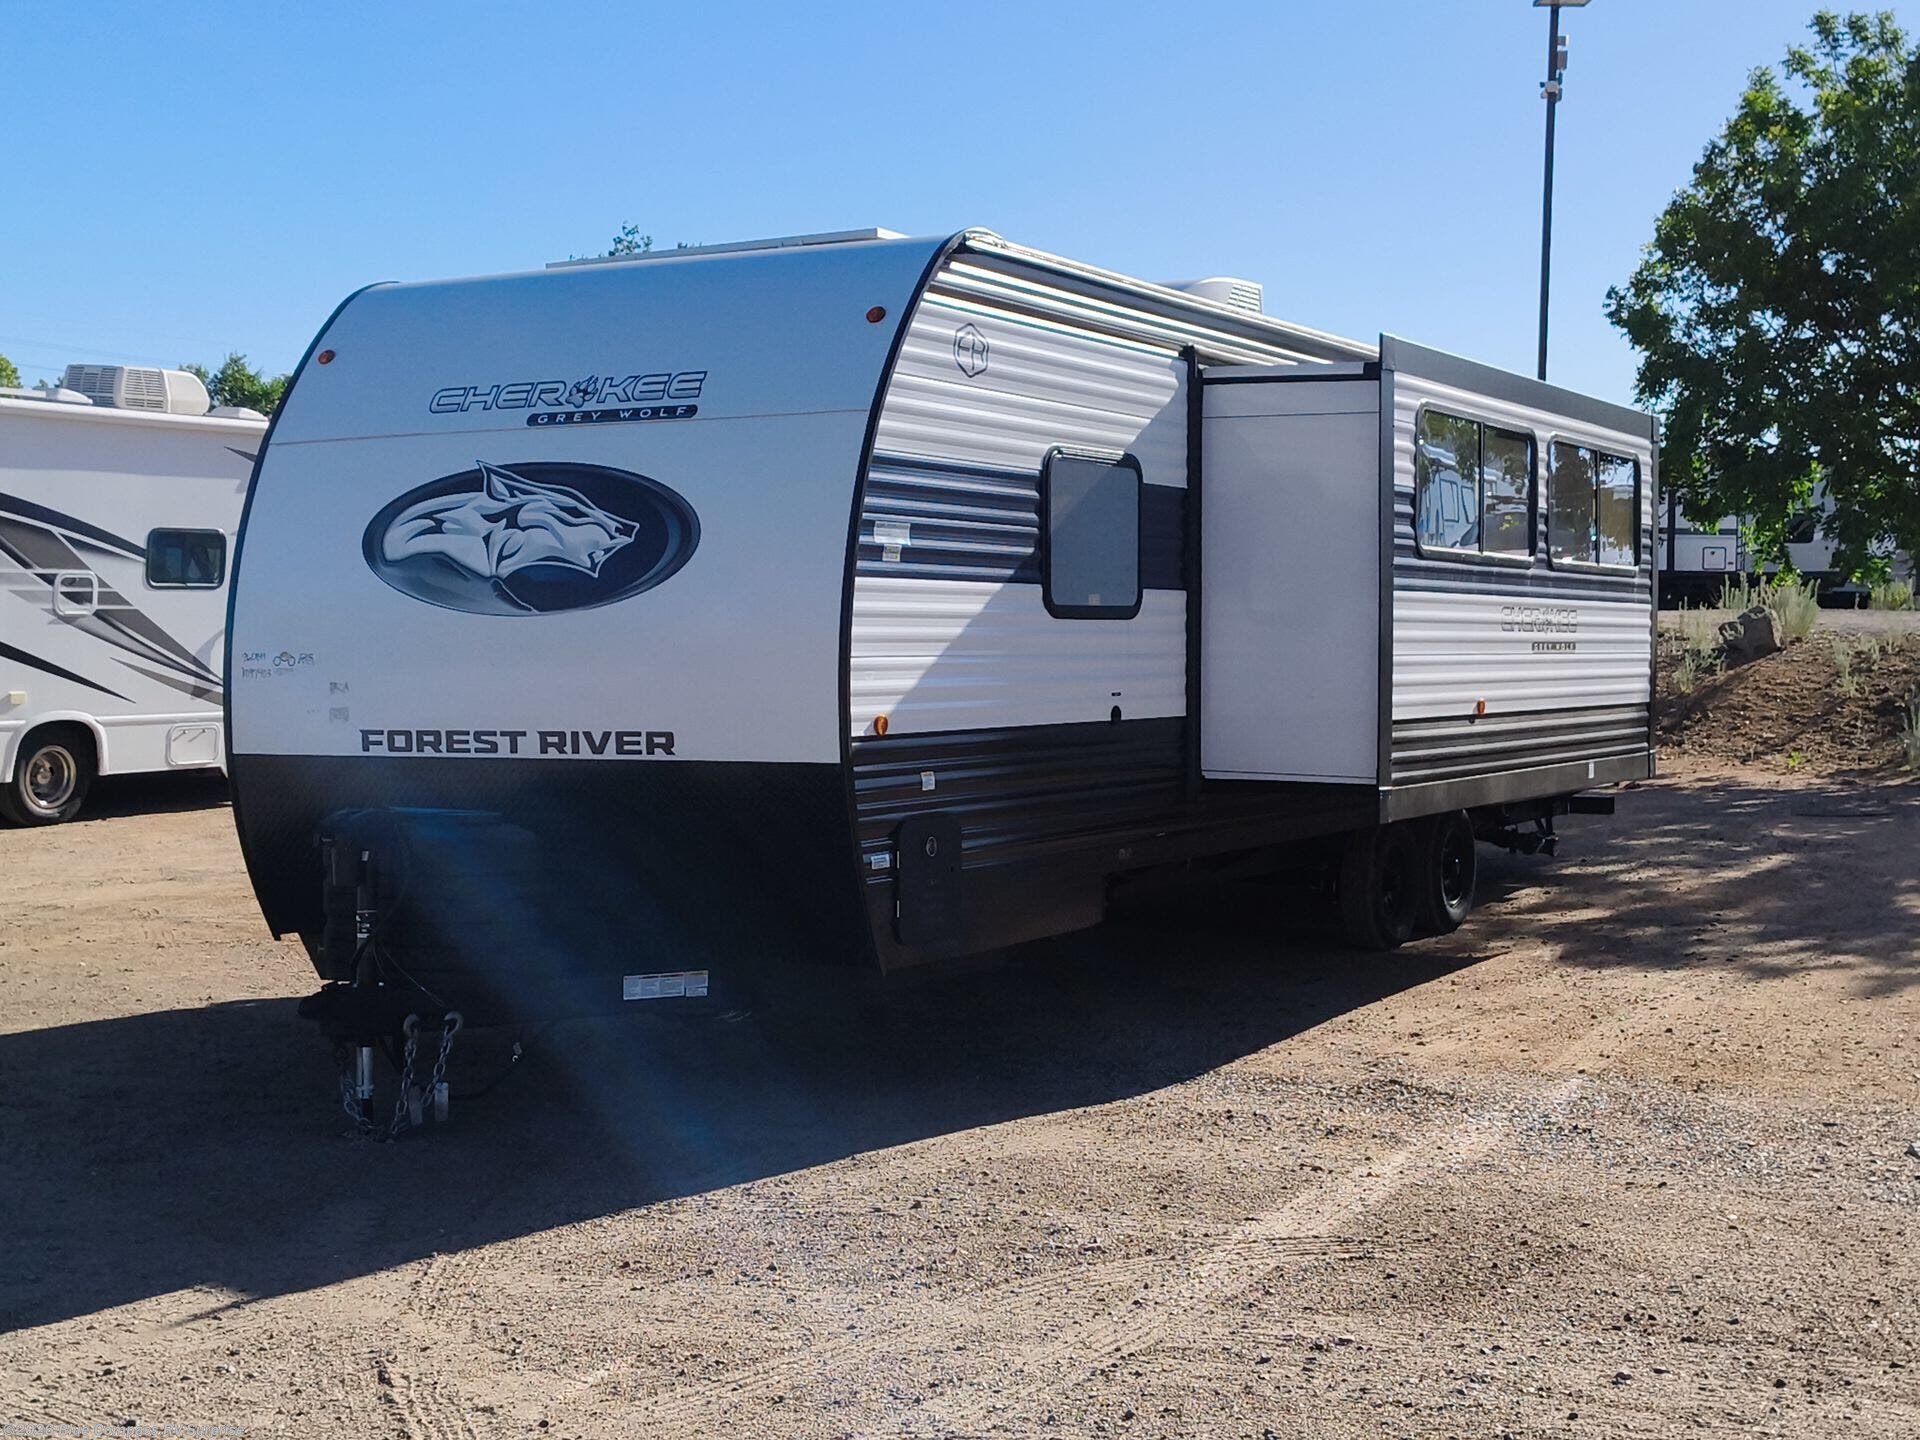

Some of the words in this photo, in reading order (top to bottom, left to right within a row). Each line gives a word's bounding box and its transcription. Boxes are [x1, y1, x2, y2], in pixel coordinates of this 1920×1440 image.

[429, 371, 708, 413] CHEROKEE
[537, 411, 601, 424] GREY
[619, 406, 688, 418] WOLF
[359, 729, 527, 754] FOREST
[536, 731, 676, 756] RIVER
